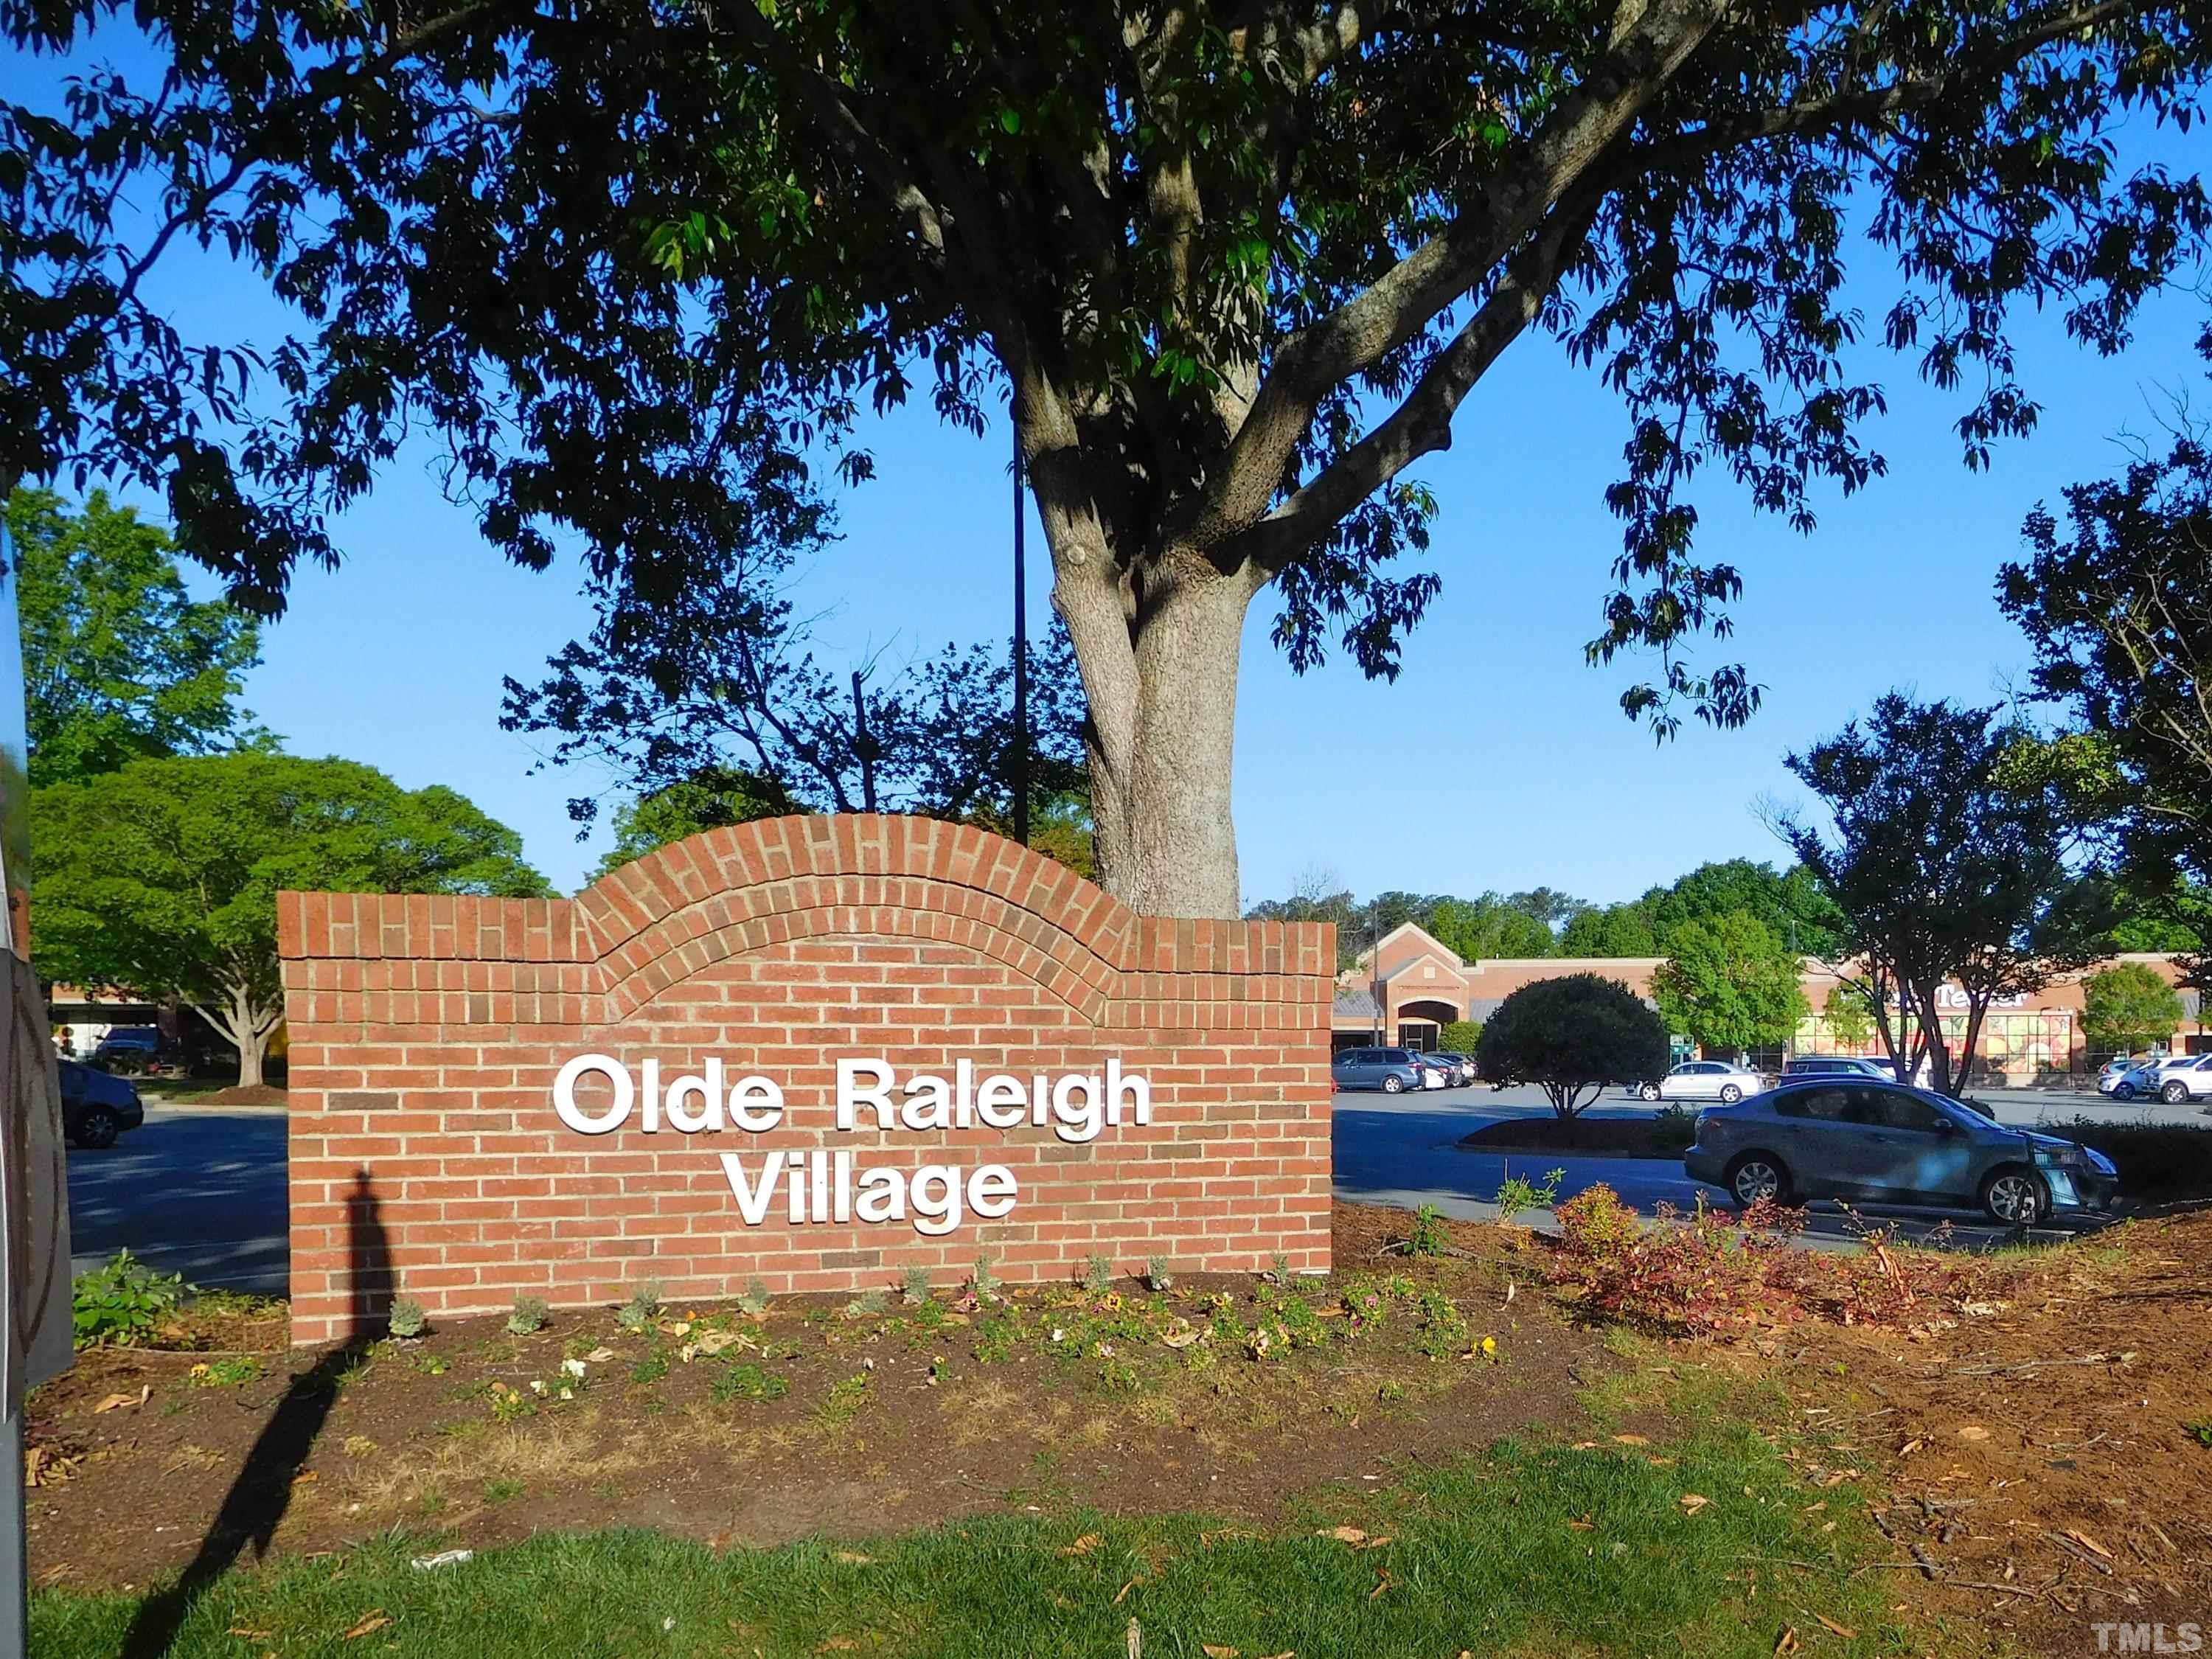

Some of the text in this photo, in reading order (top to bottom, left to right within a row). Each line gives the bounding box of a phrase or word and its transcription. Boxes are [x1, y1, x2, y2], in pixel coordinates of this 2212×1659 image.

[552, 1053, 1152, 1142] Olde Raleigh
[720, 1150, 1018, 1236] Village
